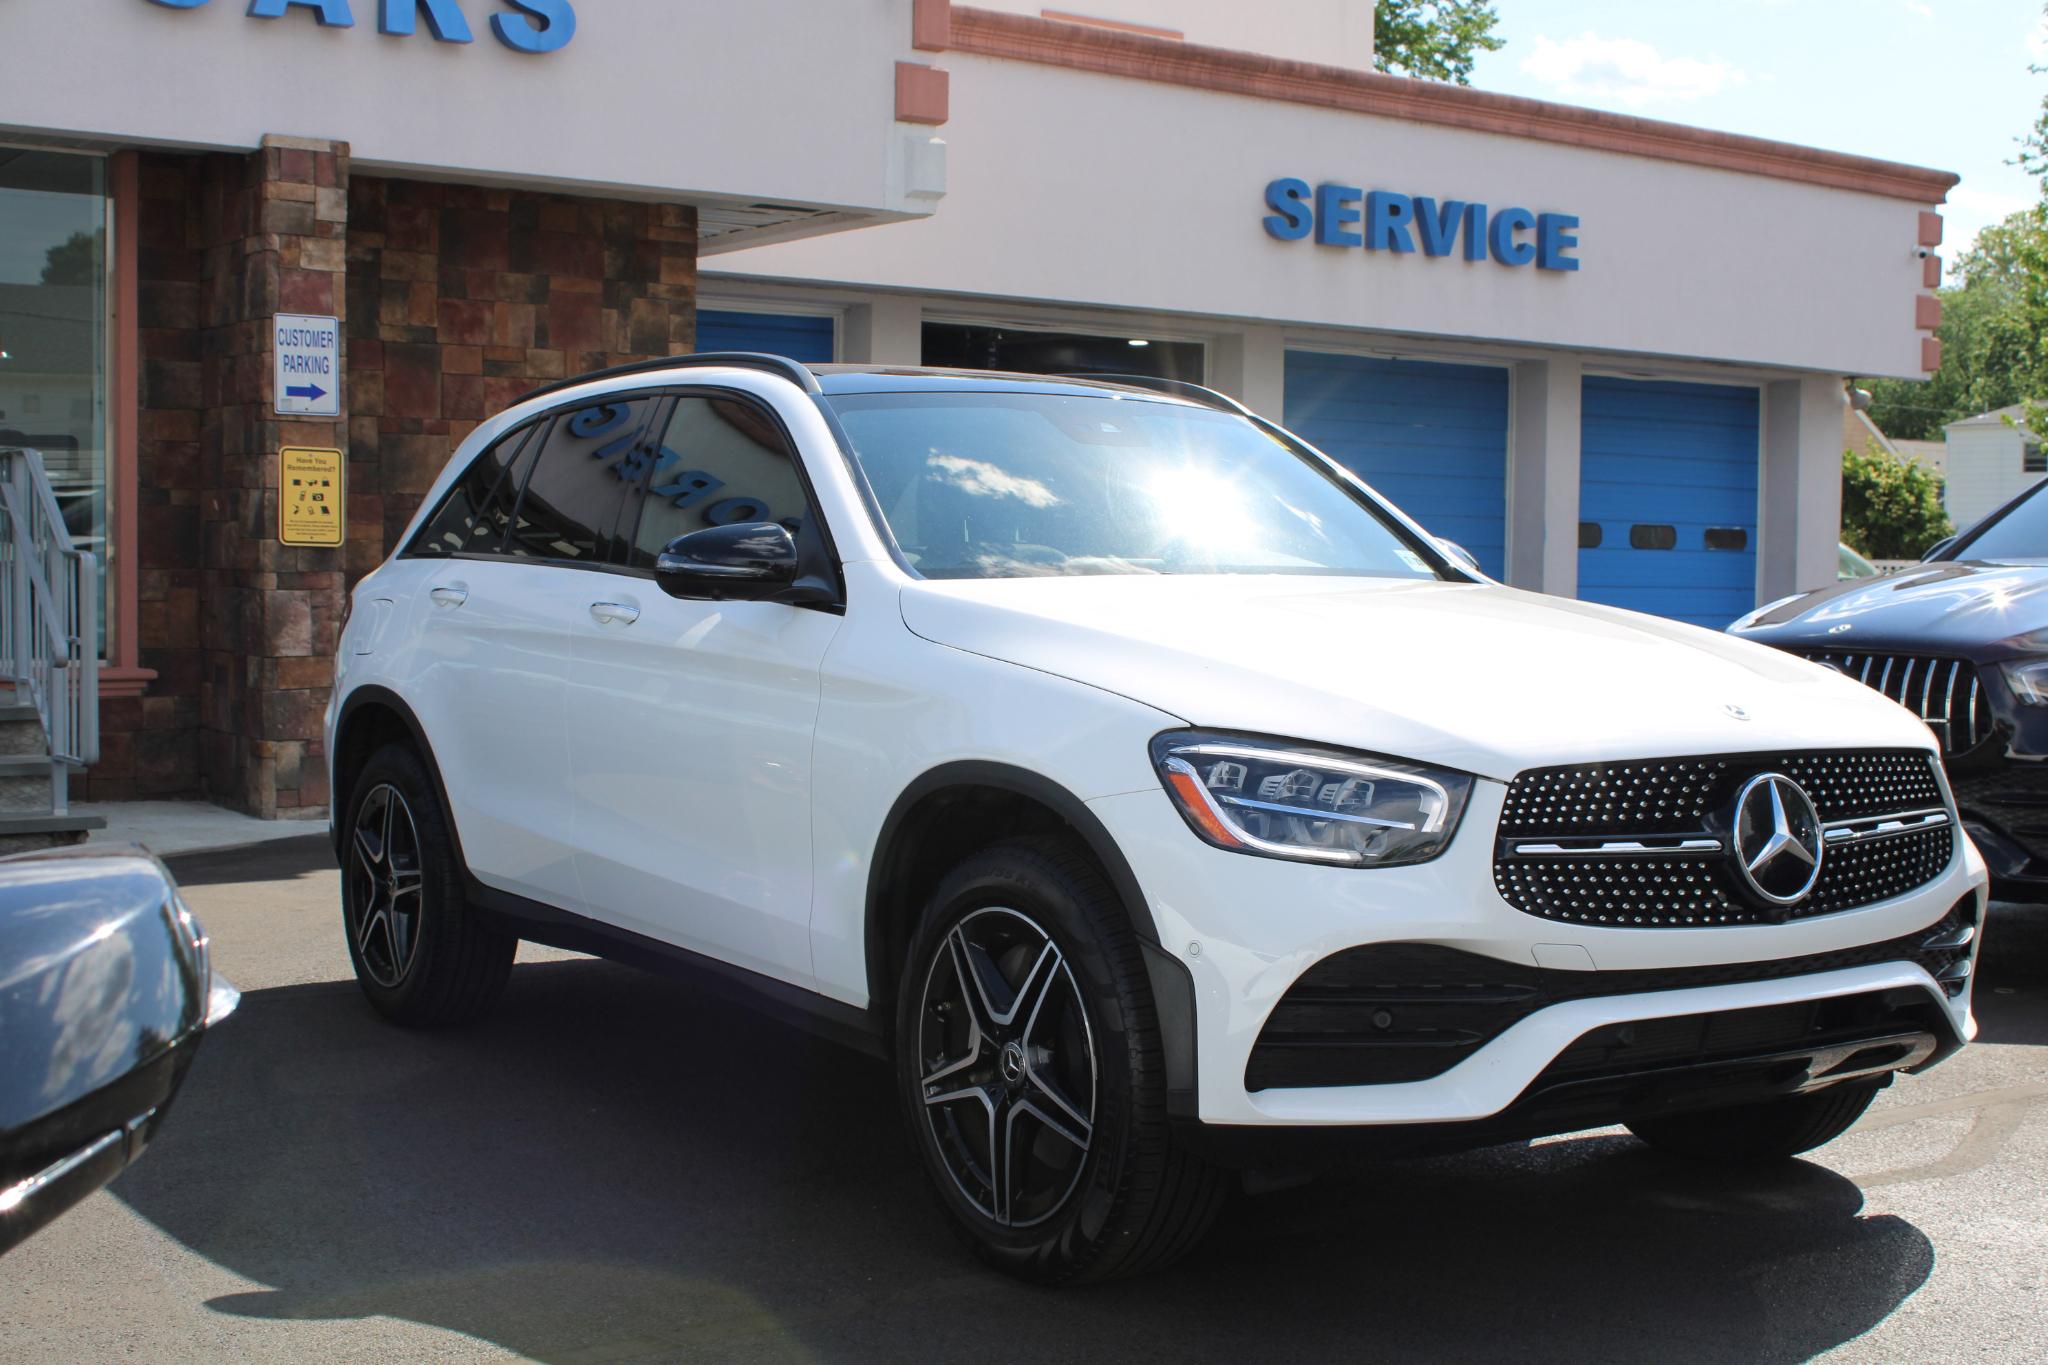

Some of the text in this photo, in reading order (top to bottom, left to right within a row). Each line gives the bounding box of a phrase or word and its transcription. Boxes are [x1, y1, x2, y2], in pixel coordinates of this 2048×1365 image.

[1263, 177, 1579, 271] SERVICE
[278, 328, 334, 348] CUSTOMER
[283, 354, 329, 374] PARKING
